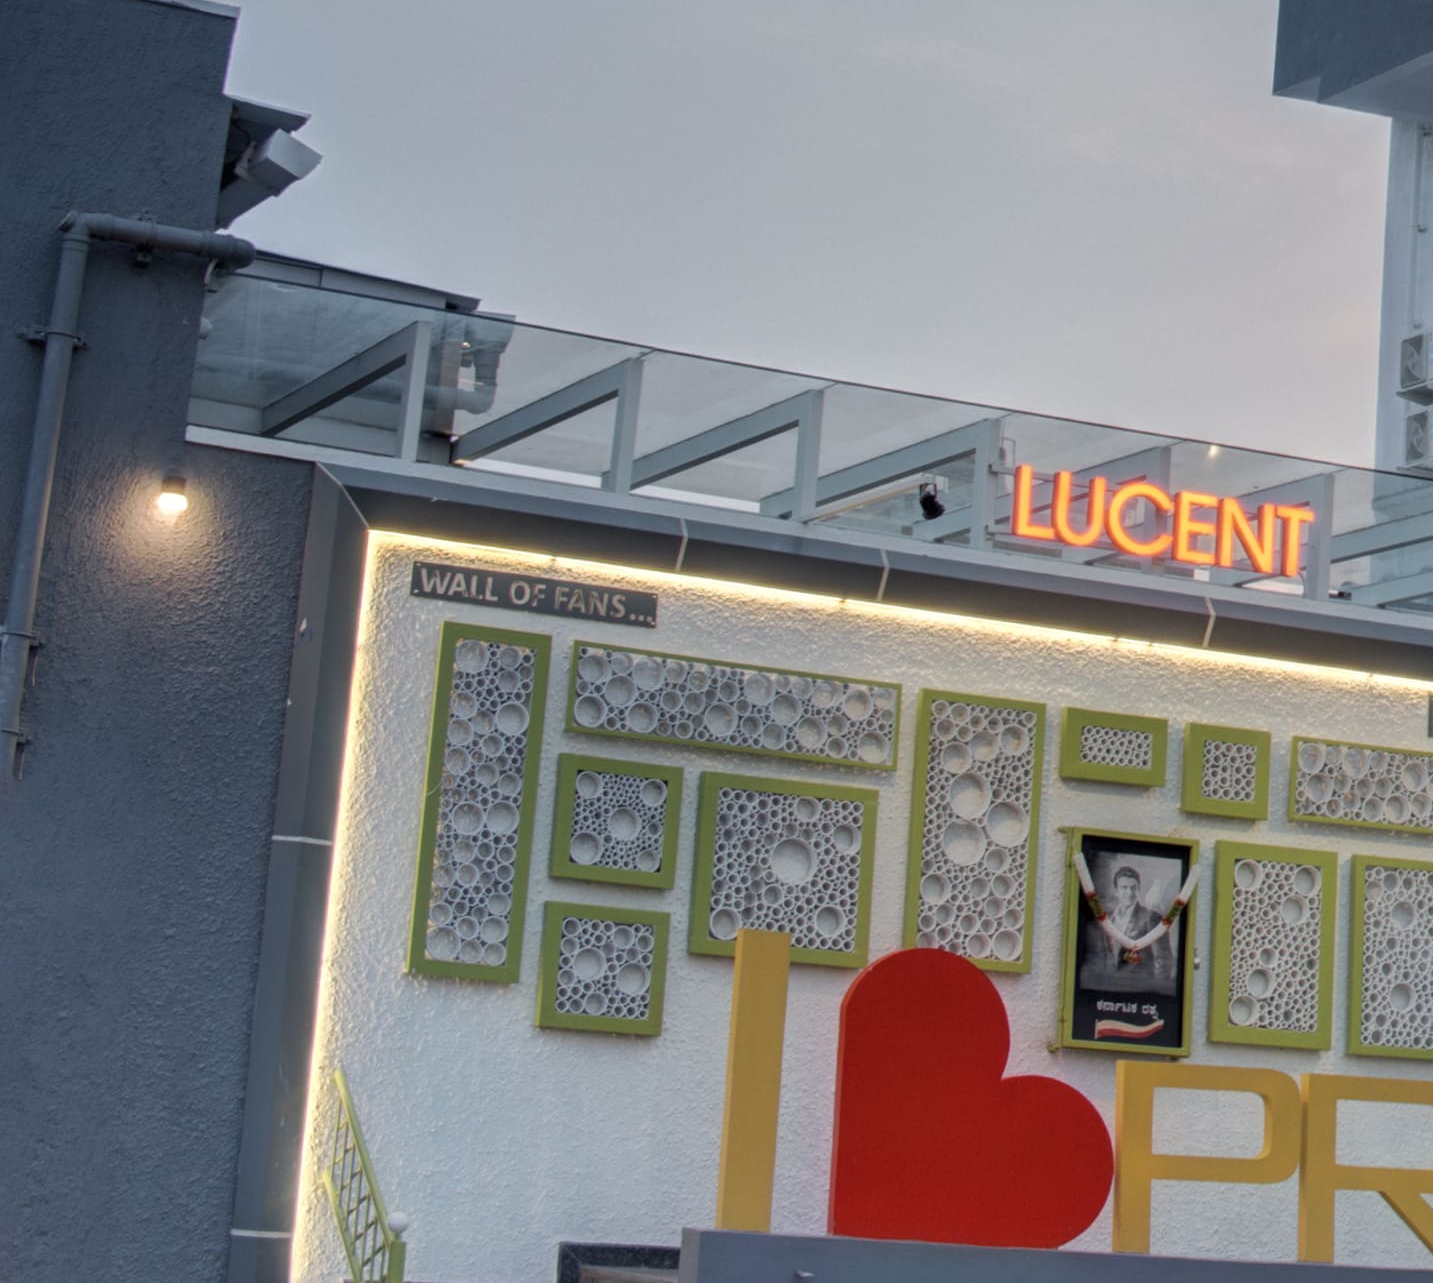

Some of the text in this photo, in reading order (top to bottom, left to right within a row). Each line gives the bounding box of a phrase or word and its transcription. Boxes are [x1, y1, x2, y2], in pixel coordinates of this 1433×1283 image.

[1011, 463, 1316, 578] LUCENT
[420, 567, 499, 602] WALL
[508, 580, 547, 607] OF
[715, 928, 792, 1233] I
